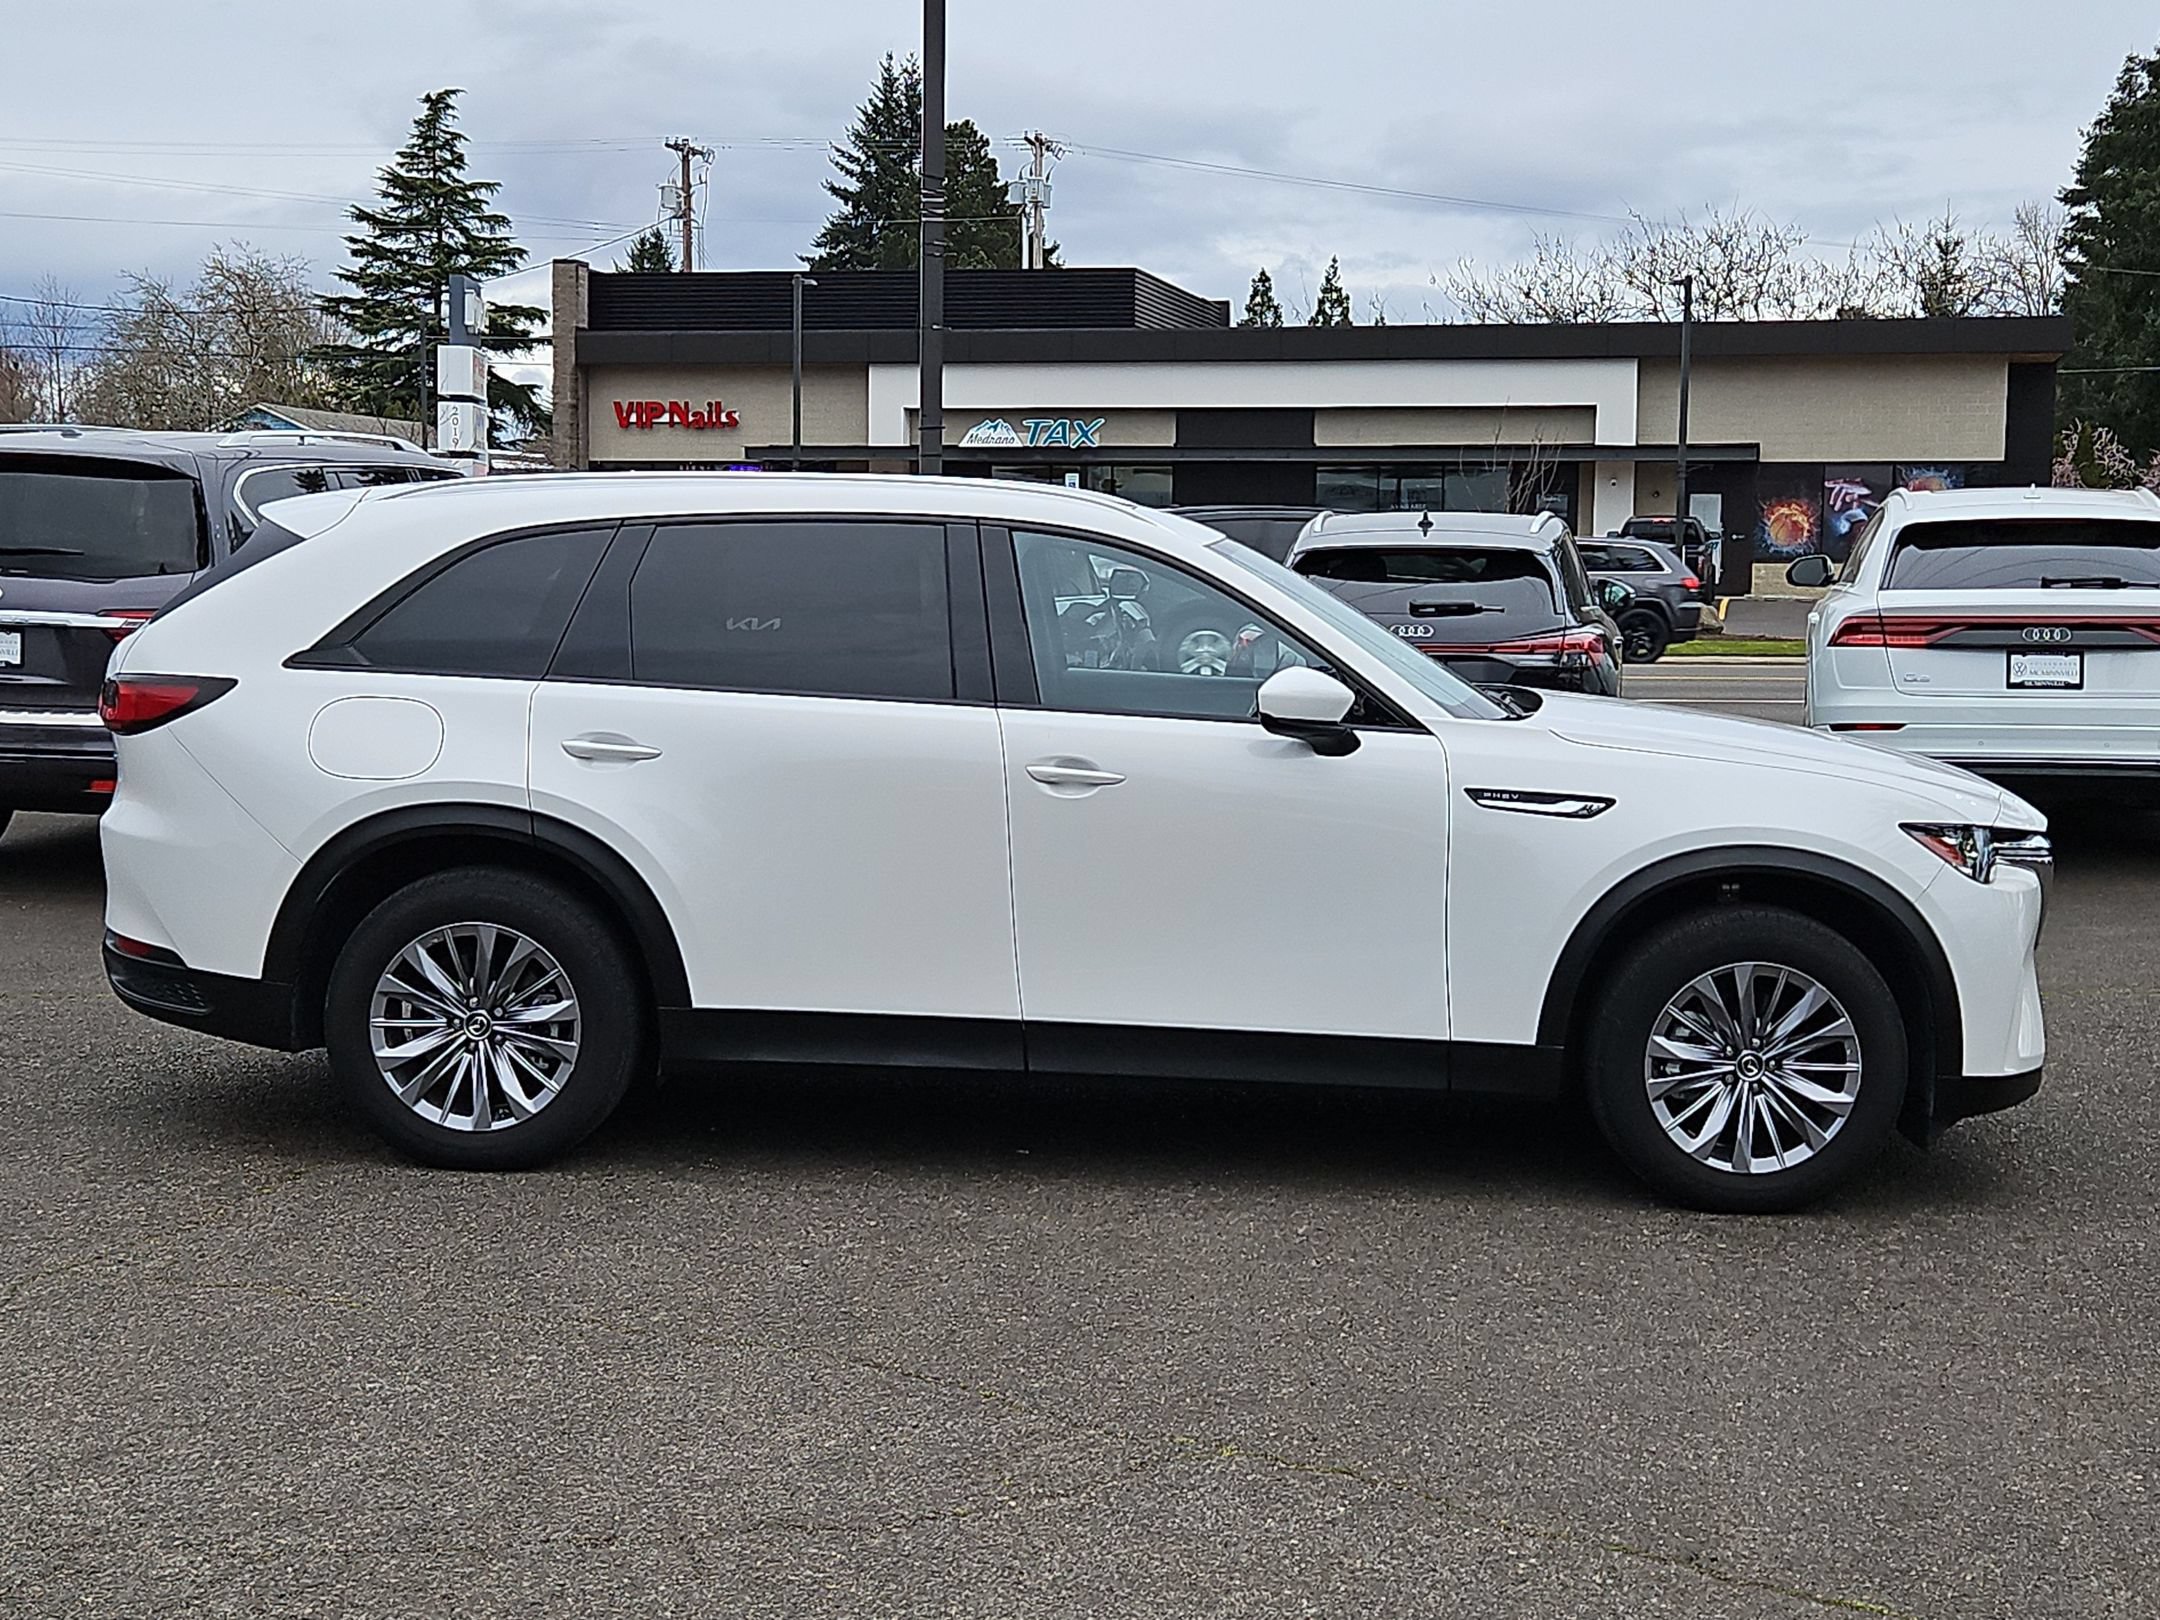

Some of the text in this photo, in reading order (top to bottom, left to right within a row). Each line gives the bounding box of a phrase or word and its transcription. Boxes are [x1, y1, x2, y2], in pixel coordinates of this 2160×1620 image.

[451, 406, 460, 449] 2019
[612, 400, 740, 430] VIP Nails
[966, 432, 1016, 446] Medrano
[1022, 418, 1105, 448] TAX
[1483, 792, 1519, 800] PHEV
